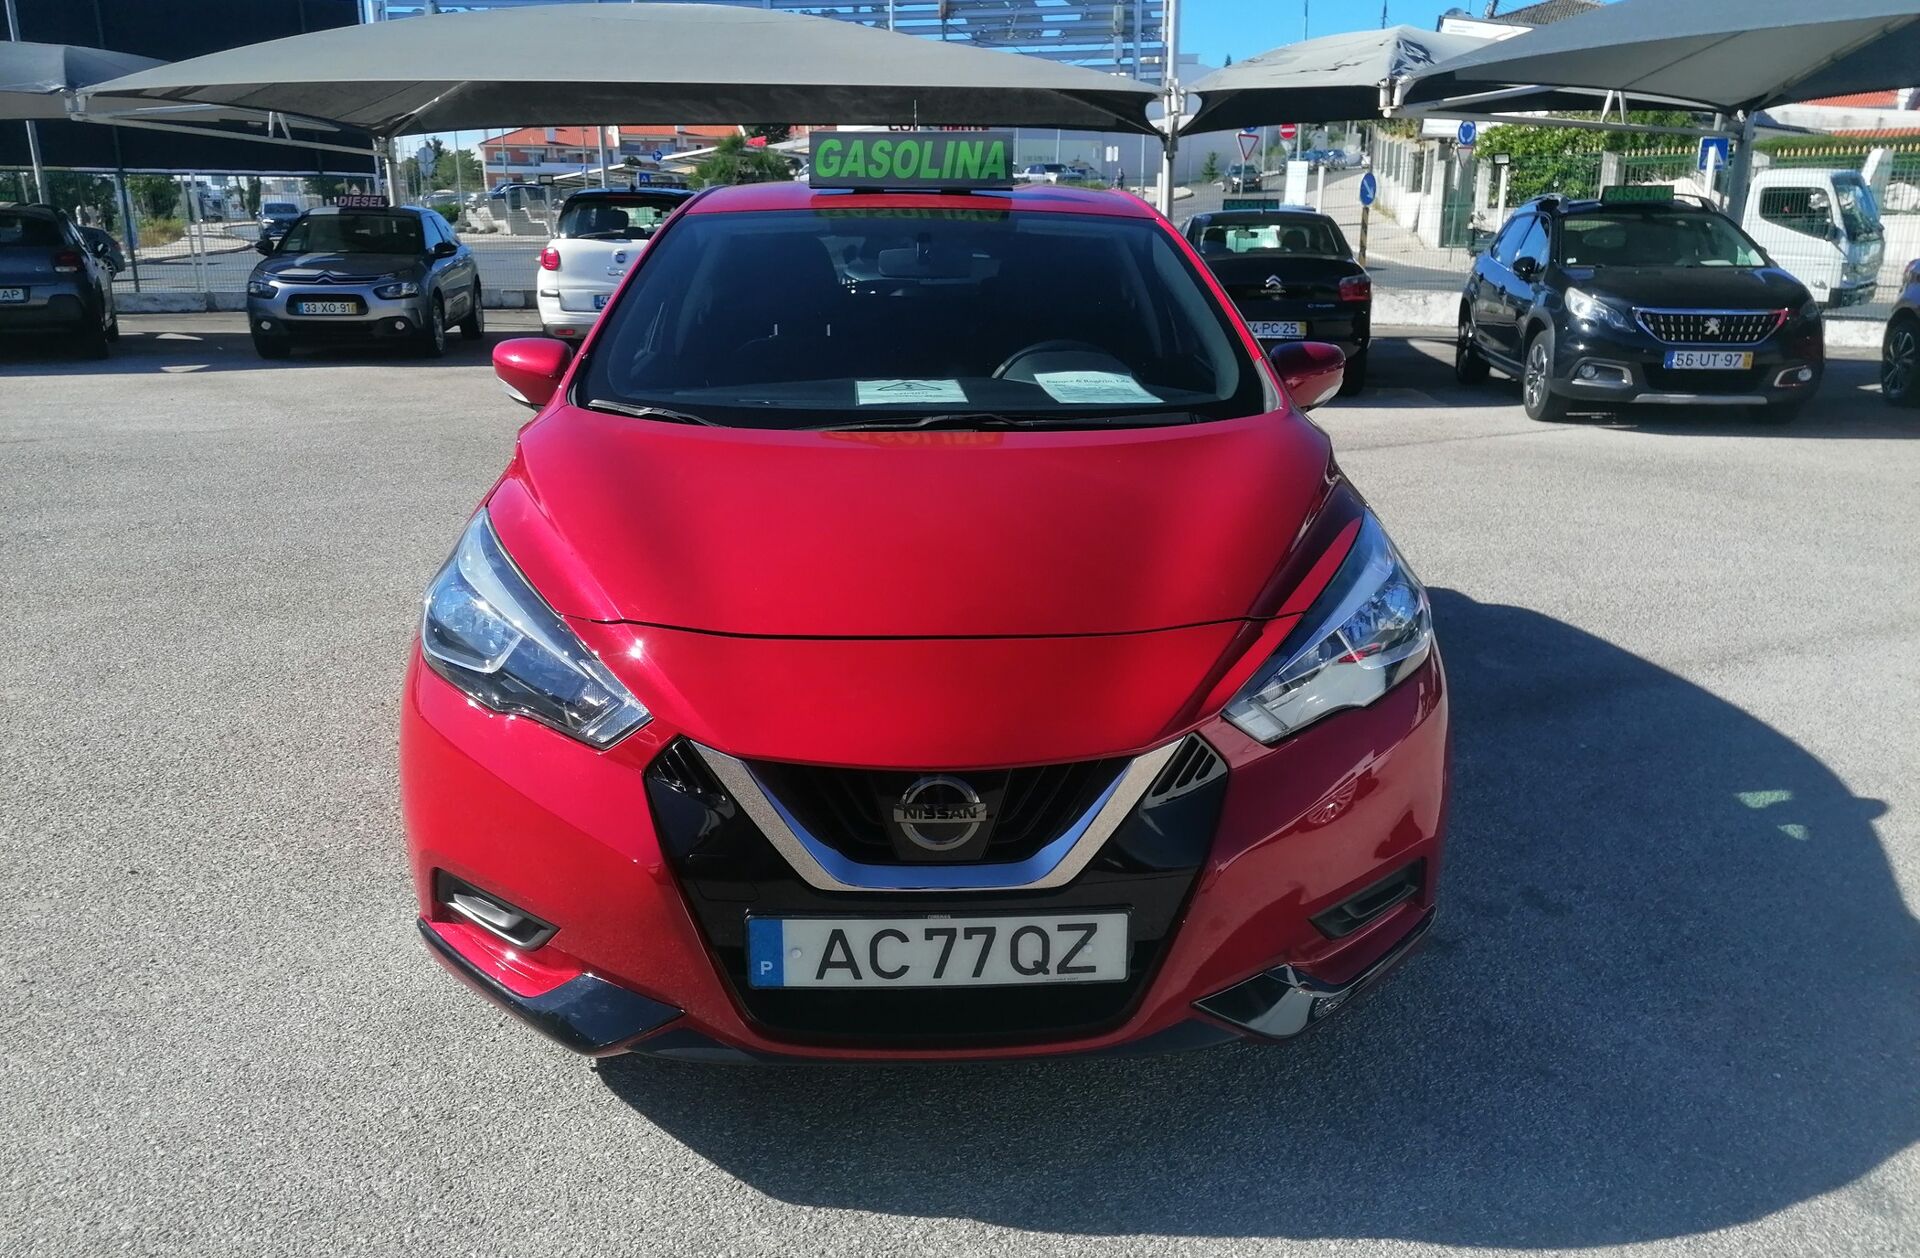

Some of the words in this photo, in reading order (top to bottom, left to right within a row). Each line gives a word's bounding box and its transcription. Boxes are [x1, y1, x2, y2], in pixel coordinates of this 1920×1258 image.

[815, 139, 1007, 179] GASOLINA
[338, 196, 385, 207] DIESEL
[903, 806, 977, 820] NISSAN
[760, 960, 774, 976] P
